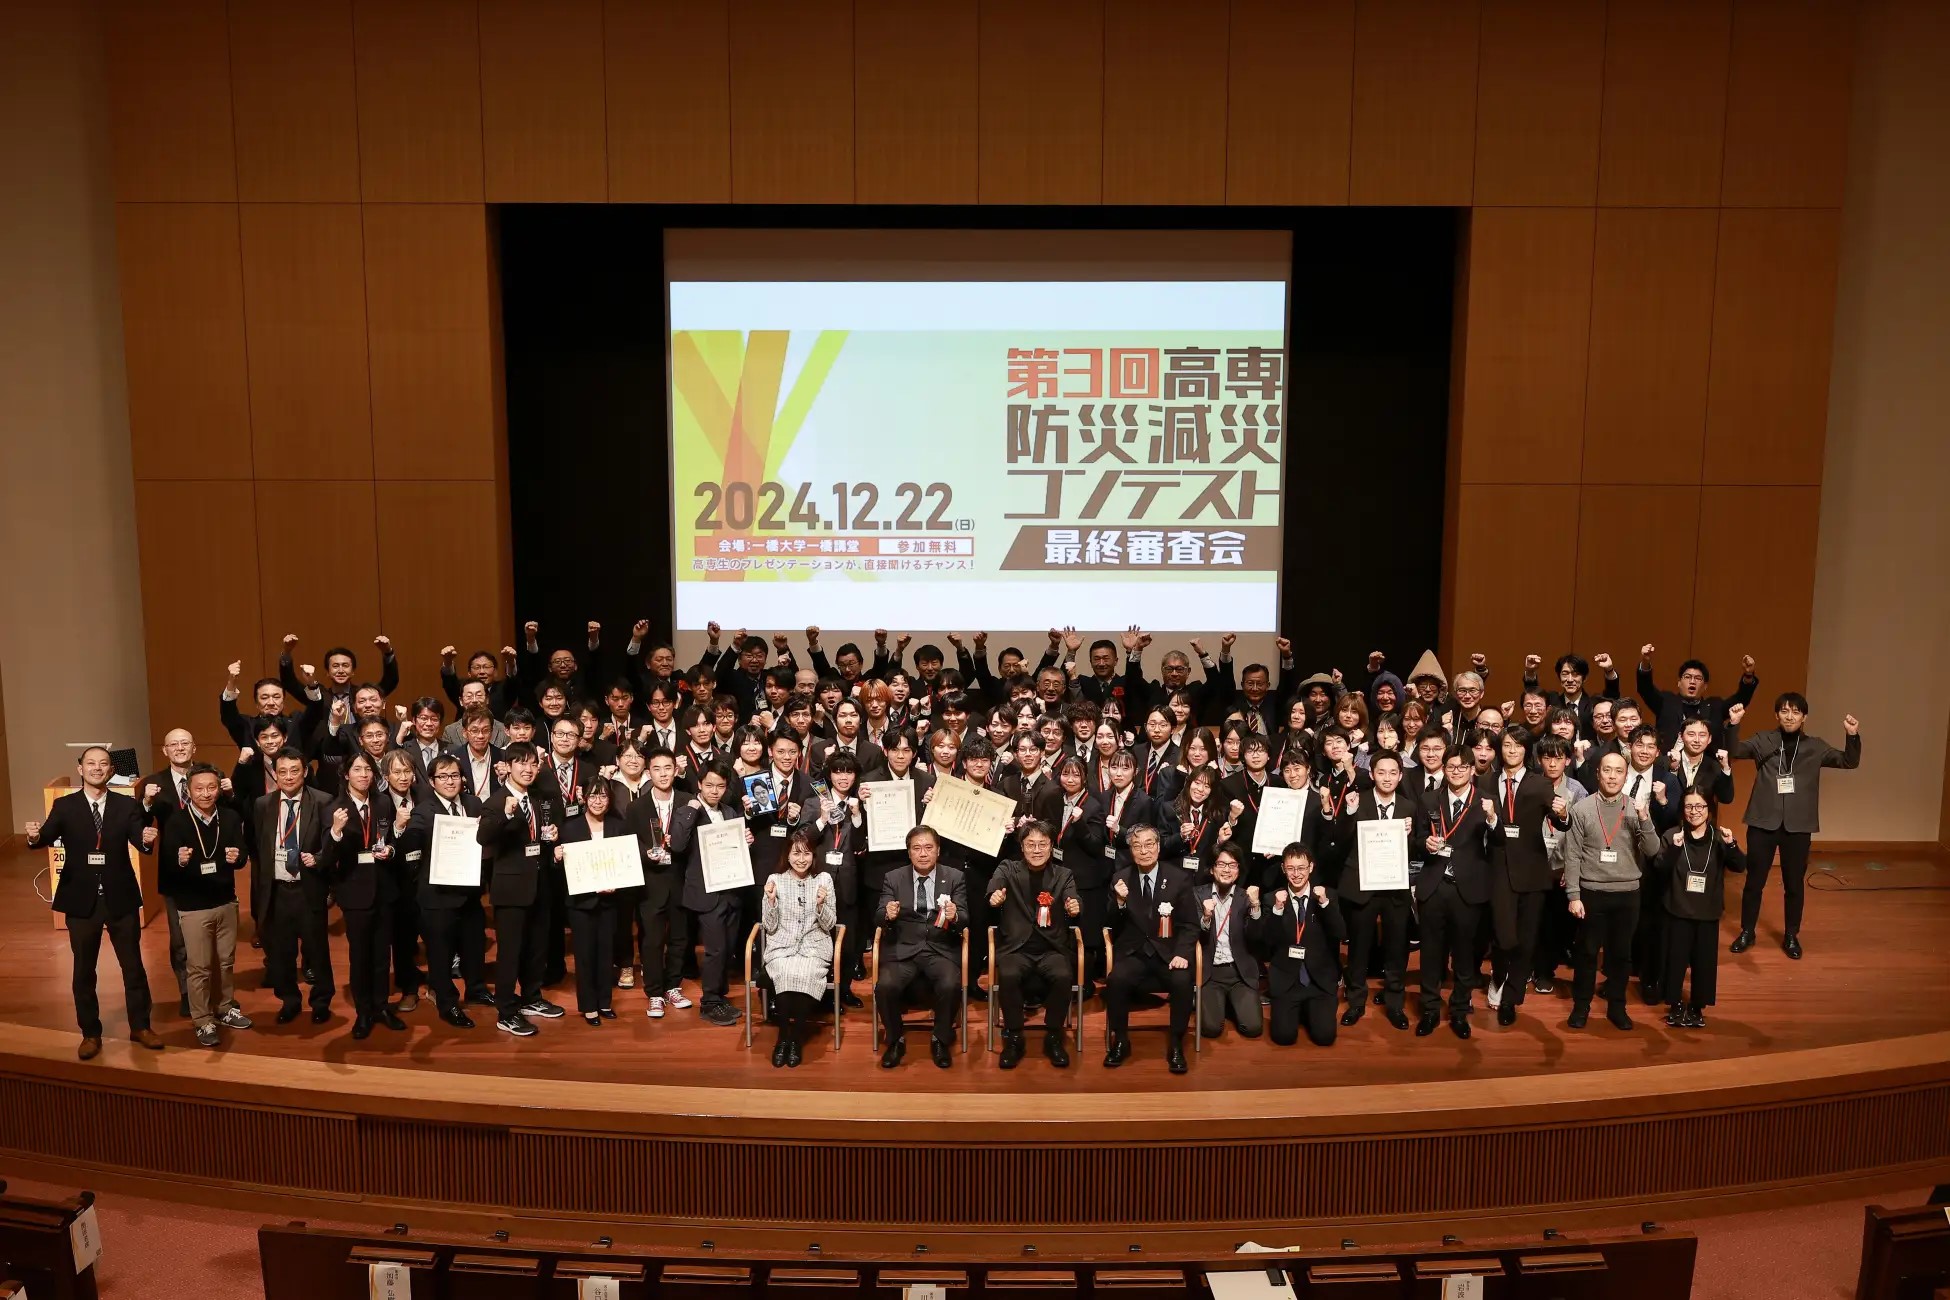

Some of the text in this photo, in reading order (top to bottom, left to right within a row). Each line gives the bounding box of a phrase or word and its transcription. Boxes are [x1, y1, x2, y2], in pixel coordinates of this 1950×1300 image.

[1007, 346, 1284, 400] 第3回高専
[1006, 404, 1281, 464] 防災減災
[1004, 470, 1280, 519] コンテスト
[897, 540, 957, 554] 参加無料
[1044, 529, 1246, 565] 最終審査会
